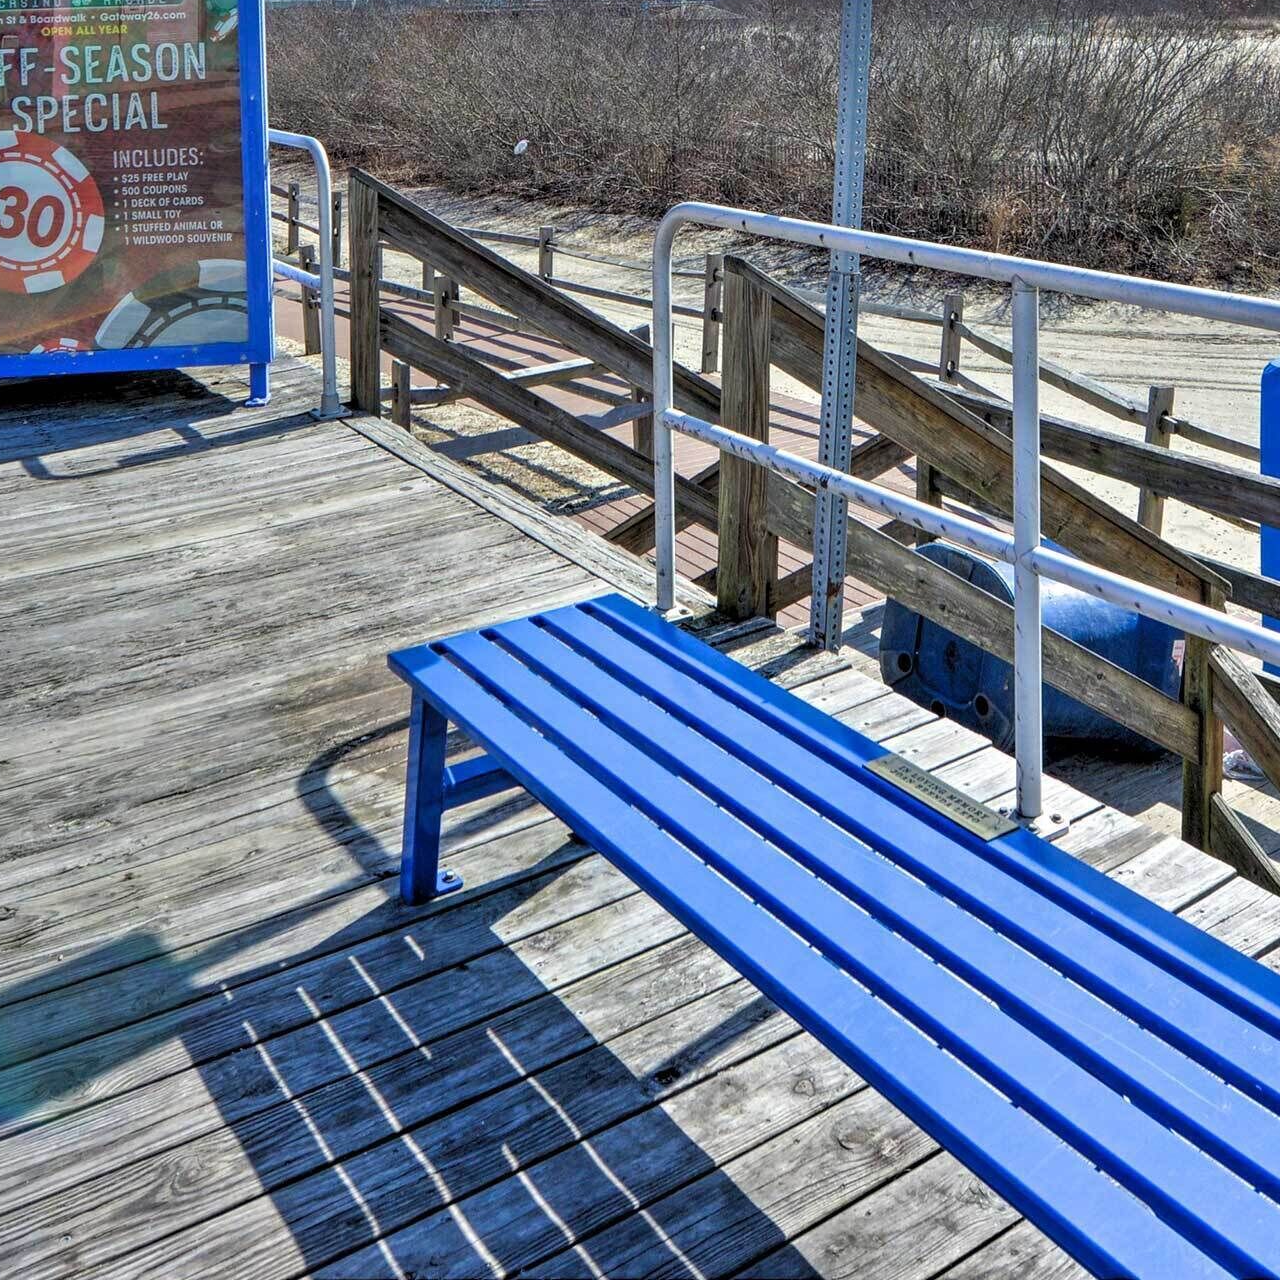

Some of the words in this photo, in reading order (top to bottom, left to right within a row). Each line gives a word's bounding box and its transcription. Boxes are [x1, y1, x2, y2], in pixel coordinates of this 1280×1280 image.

[6, 15, 16, 24] St
[19, 15, 27, 24] &
[30, 12, 86, 24] Boardwalk
[100, 11, 186, 22] Gateway26.com
[41, 26, 72, 37] OPEN
[76, 25, 96, 35] ALL
[98, 24, 128, 34] YEAR
[11, 91, 168, 134] SPECIAL
[113, 147, 204, 168] INCLUDES:
[122, 173, 139, 183] $25
[142, 172, 164, 182] FREE
[166, 172, 189, 181] PLAY
[122, 186, 140, 195] 500
[142, 184, 188, 195] COUPONS
[123, 199, 127, 208] 1
[131, 198, 156, 208] DECK
[158, 197, 170, 206] OF
[173, 196, 204, 206] CARDS
[123, 211, 128, 220] 1
[131, 211, 161, 220] SMALL
[164, 210, 181, 219] TOY
[124, 224, 128, 233] 1
[132, 222, 171, 232] STUFFED
[173, 221, 208, 231] ANIMAL
[210, 220, 223, 229] OR
[125, 236, 129, 245] 1
[133, 234, 185, 245] WILDWOOD
[187, 232, 233, 243] SOUVENIR
[899, 765, 910, 774] IN
[911, 772, 947, 795] LOVING
[947, 793, 991, 819] MEMORY
